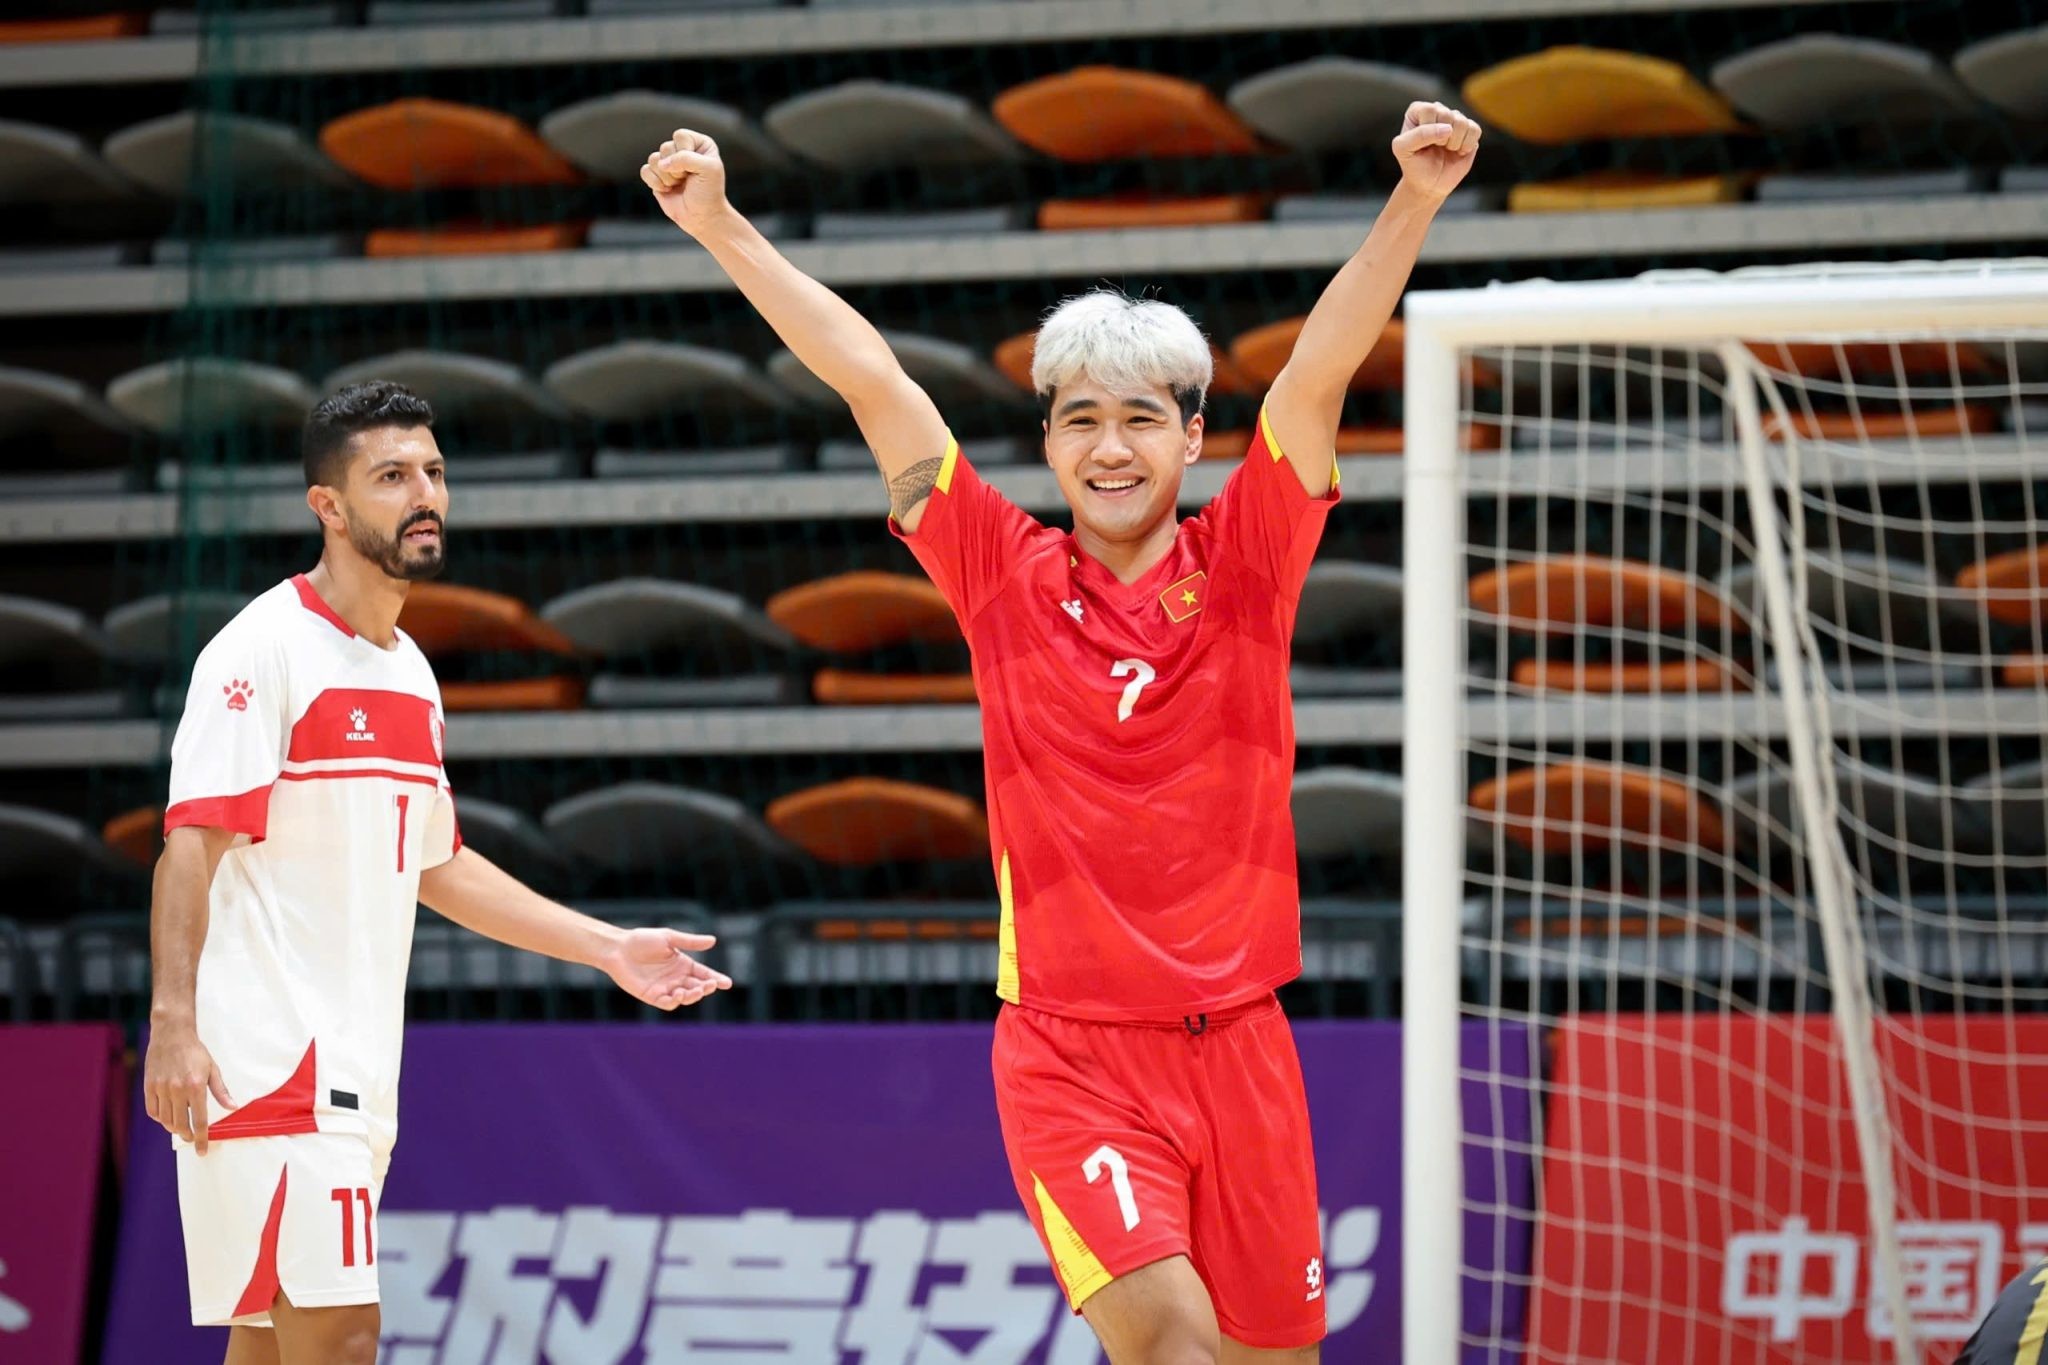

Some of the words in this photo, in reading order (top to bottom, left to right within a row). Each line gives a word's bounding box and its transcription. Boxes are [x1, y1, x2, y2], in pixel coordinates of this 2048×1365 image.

[1110, 658, 1157, 724] 7
[345, 731, 376, 742] KELME
[1080, 1144, 1142, 1233] 7
[331, 1187, 374, 1267] 11
